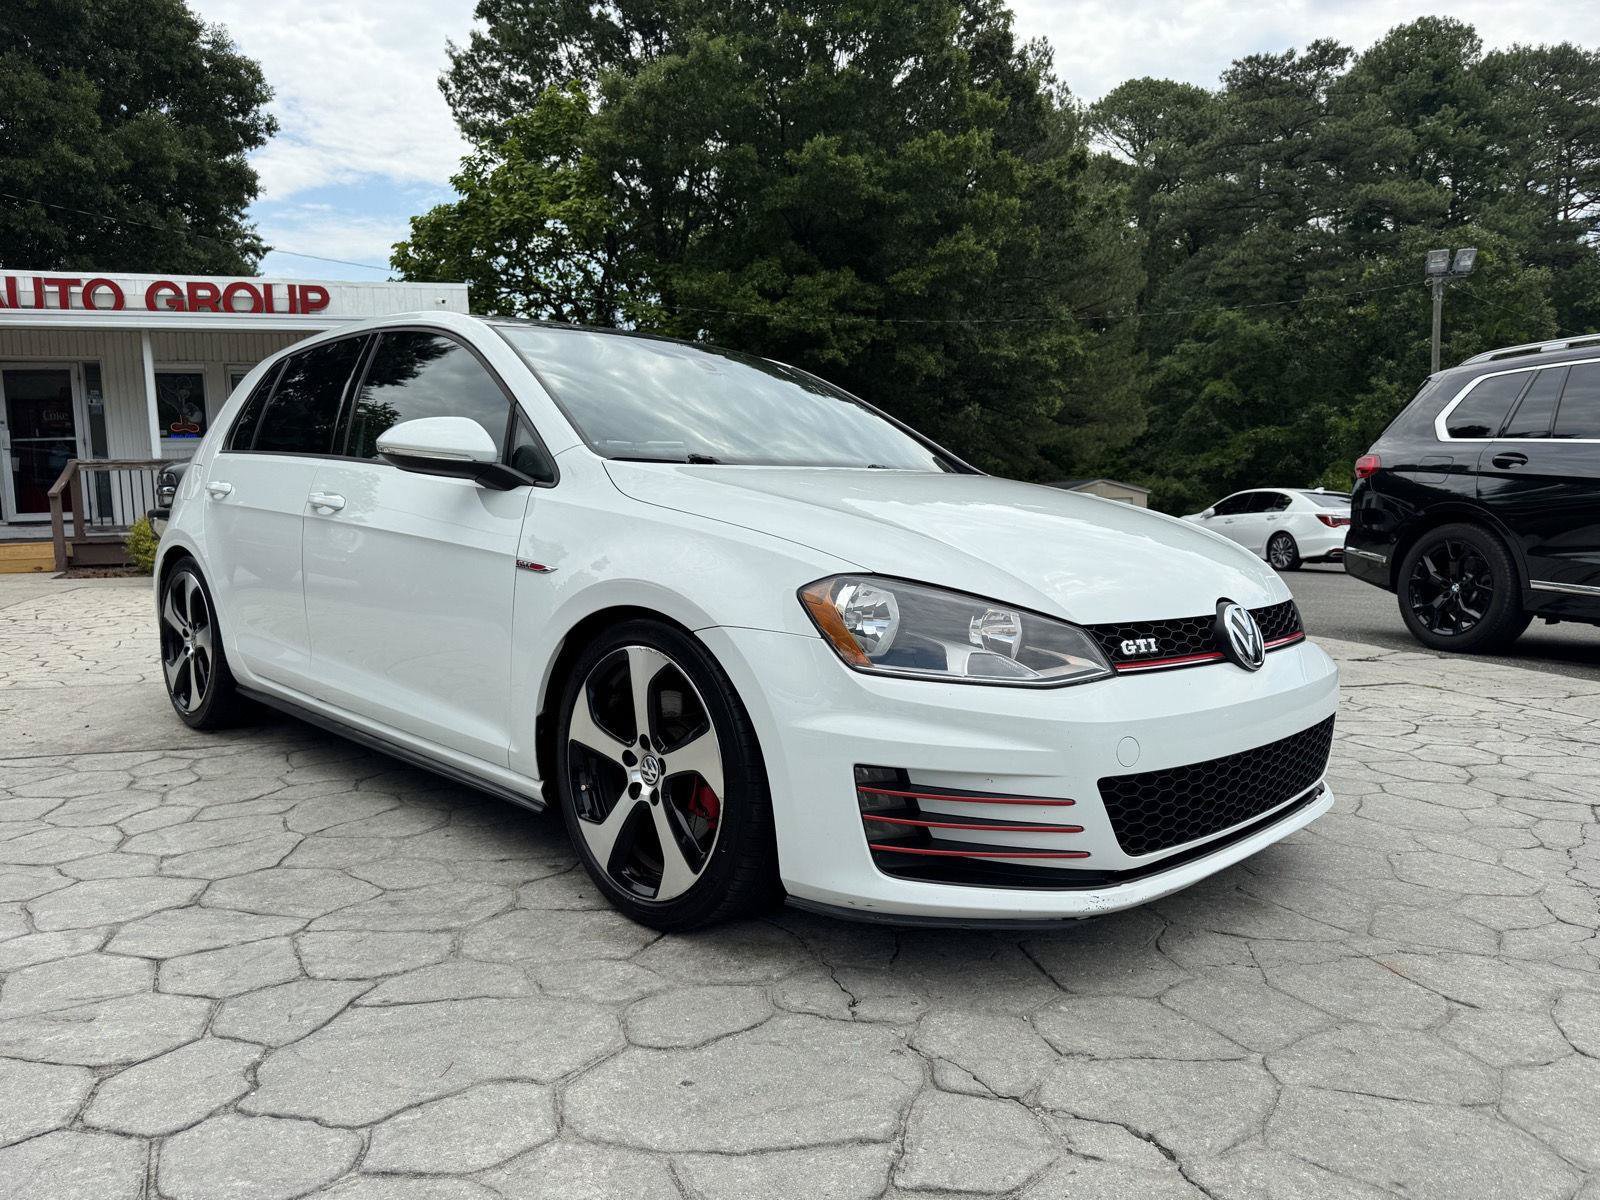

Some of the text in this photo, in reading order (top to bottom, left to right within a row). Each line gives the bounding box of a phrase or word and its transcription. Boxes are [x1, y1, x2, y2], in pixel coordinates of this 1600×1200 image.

[0, 276, 331, 314] UTO GROUP
[1120, 637, 1159, 656] GTI
